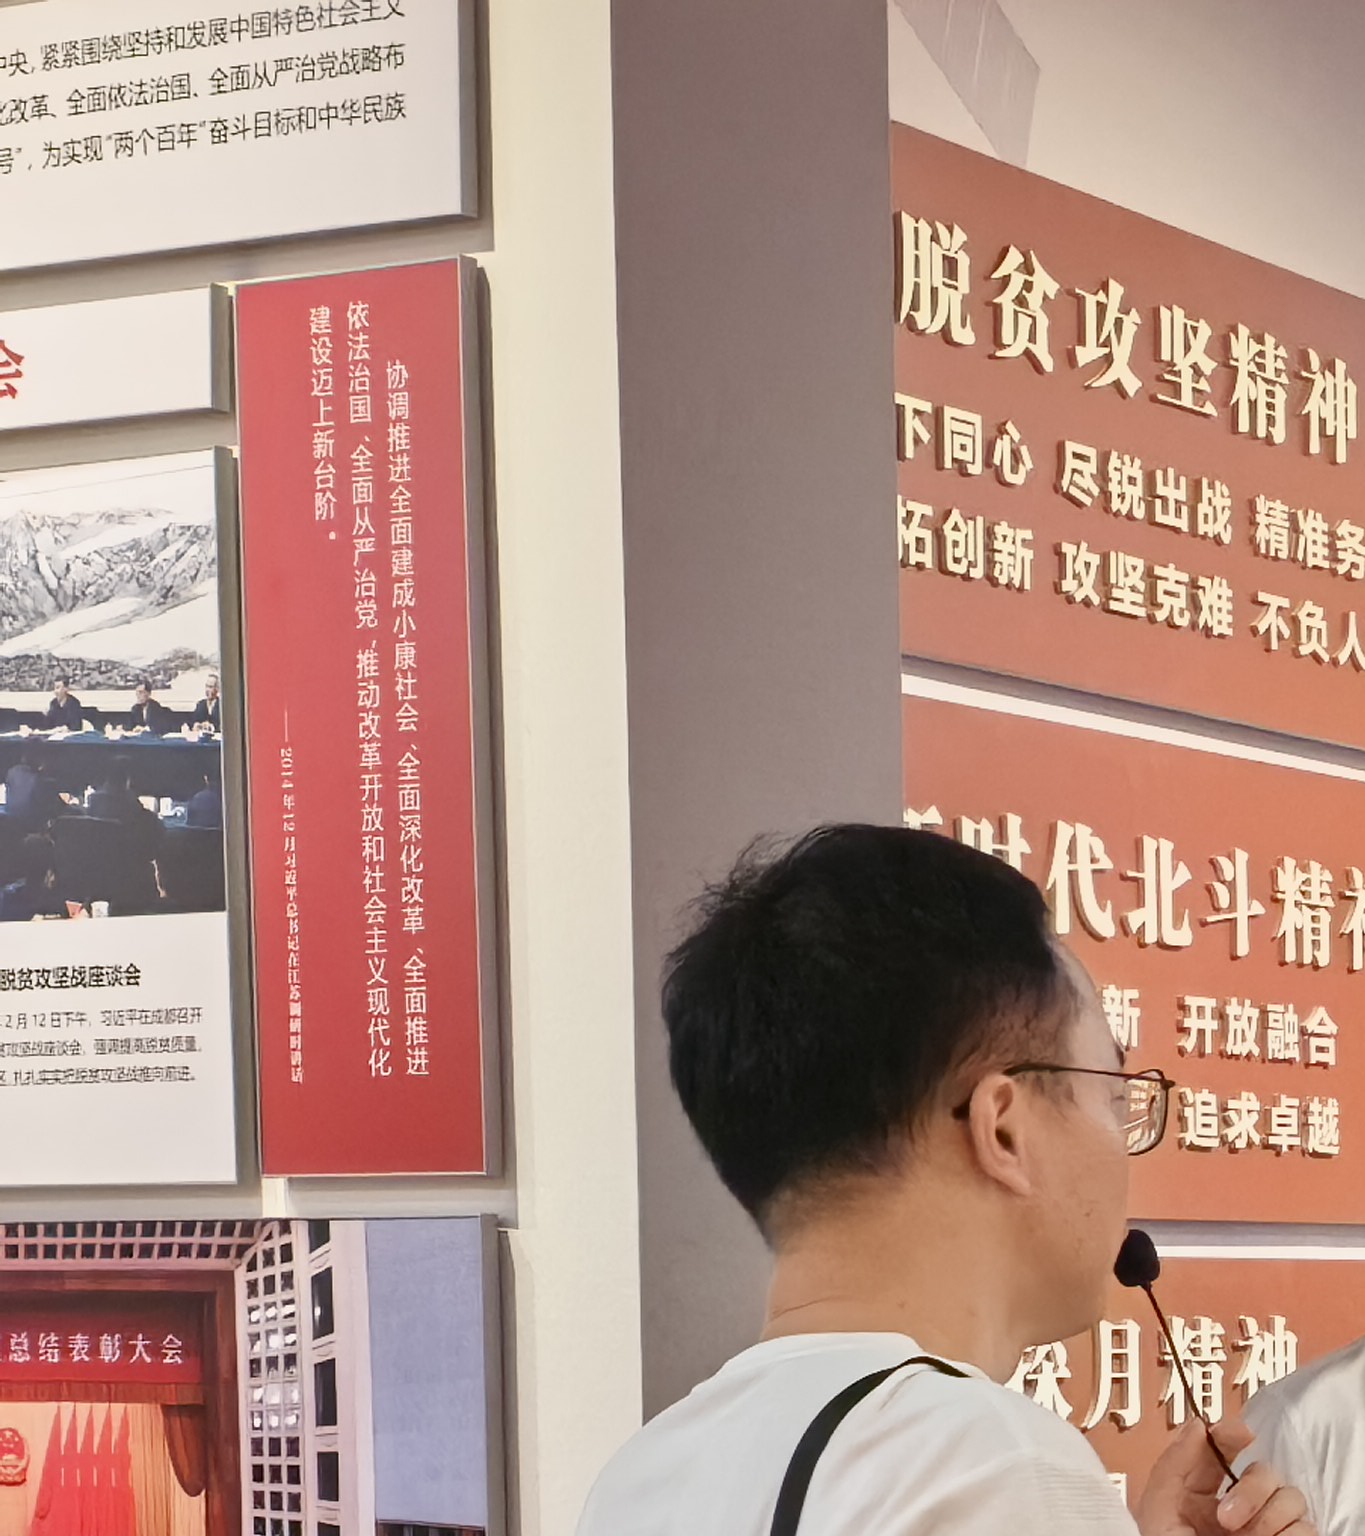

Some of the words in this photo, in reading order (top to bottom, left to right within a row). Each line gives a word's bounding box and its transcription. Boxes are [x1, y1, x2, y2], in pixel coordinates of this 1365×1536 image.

[897, 210, 1358, 464] 脱贫攻坚精神
[309, 305, 338, 541] 建设迈上新台阶。
[895, 392, 1033, 486] 下同心
[1060, 440, 1233, 545] 尽锐出战
[1059, 541, 1233, 638] 攻坚克难
[1179, 995, 1340, 1067] 开放融合
[1179, 1088, 1341, 1156] 追求卓越
[8, 1331, 184, 1364] 总结表彰大会
